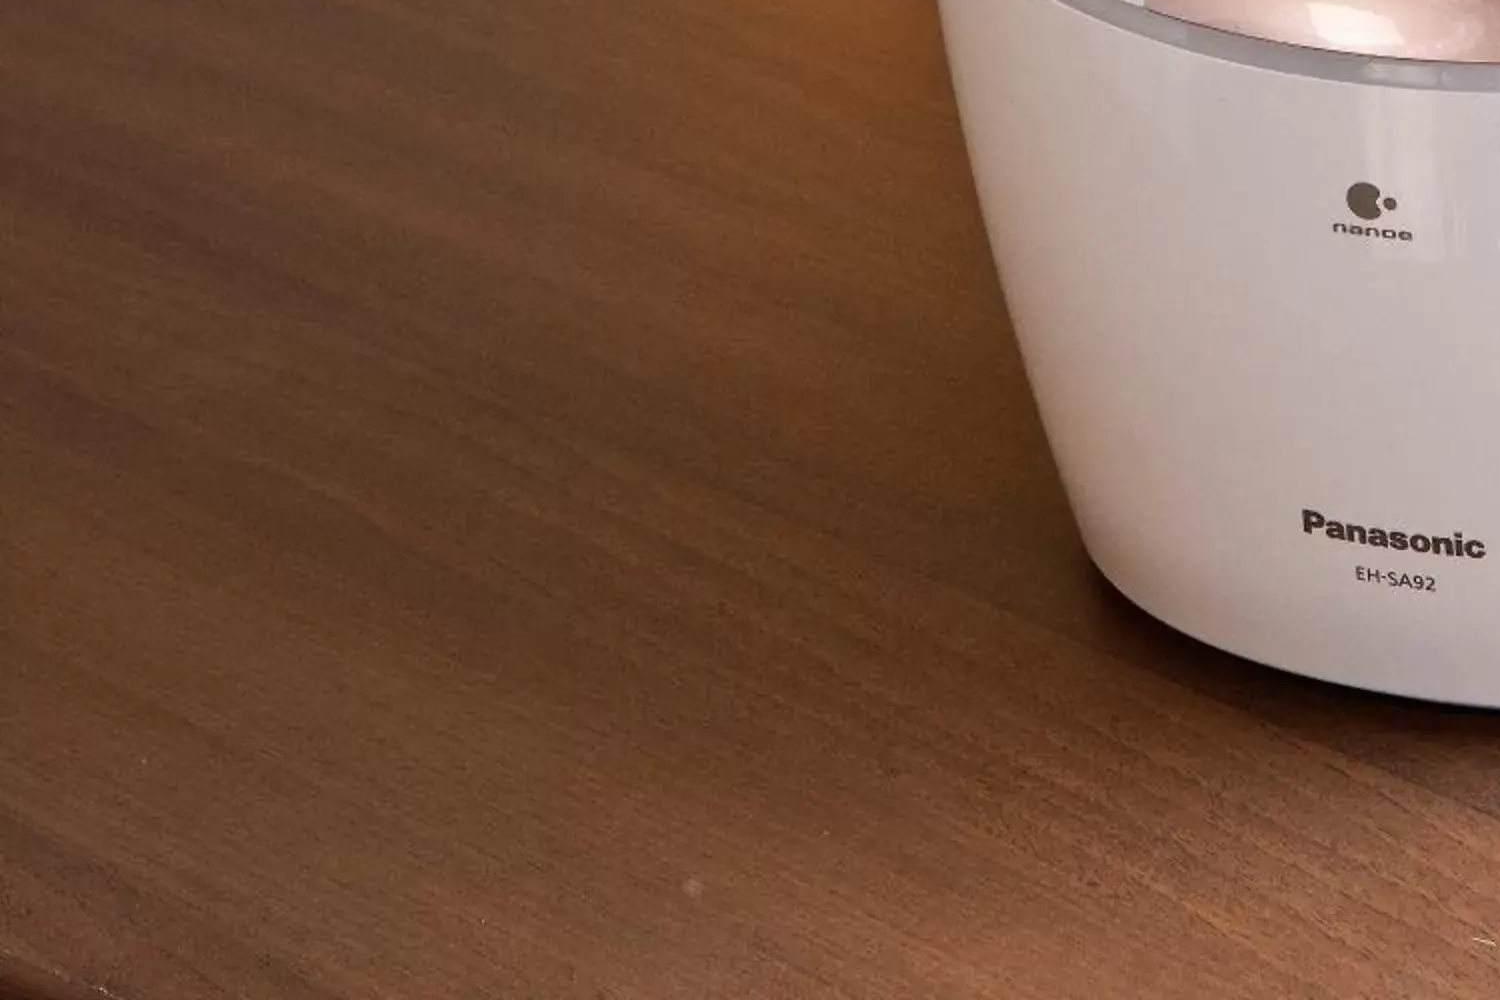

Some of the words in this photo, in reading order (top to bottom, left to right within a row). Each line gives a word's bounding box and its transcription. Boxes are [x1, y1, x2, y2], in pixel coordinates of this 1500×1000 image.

[1332, 222, 1413, 242] nanoe
[1301, 508, 1487, 559] Panasonic
[1355, 565, 1437, 592] EH-SA92
